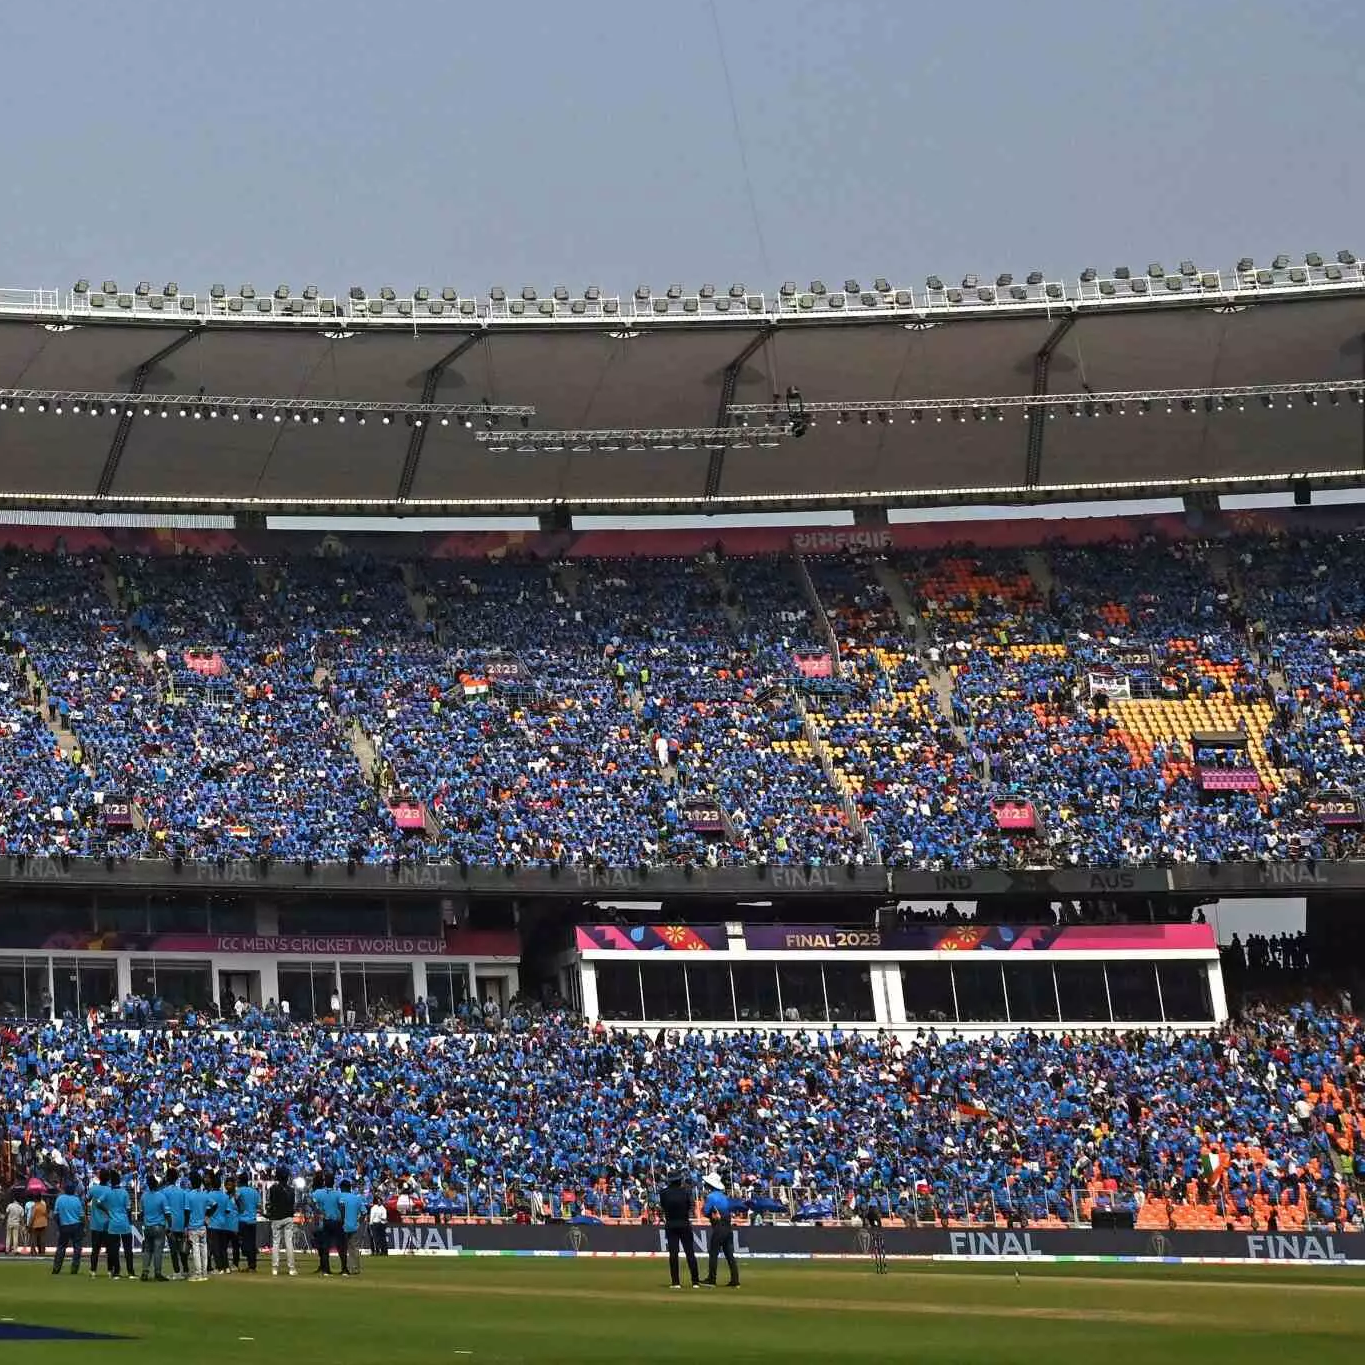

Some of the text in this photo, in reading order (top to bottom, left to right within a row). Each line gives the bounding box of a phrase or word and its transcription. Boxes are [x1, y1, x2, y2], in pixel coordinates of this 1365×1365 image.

[10, 859, 71, 880] FINAL
[387, 865, 448, 885] FINAL
[575, 865, 640, 887] FINAL
[771, 866, 838, 887] FINAL
[1259, 864, 1327, 883] FINAL
[934, 874, 973, 891] IND
[1090, 874, 1135, 890] AUS
[218, 937, 447, 953] ICC MEN'S CRICKET WORLD CUP
[785, 933, 882, 947] FINAL 2023
[949, 1231, 1042, 1256] FINAL
[1246, 1234, 1346, 1260] FINAL
